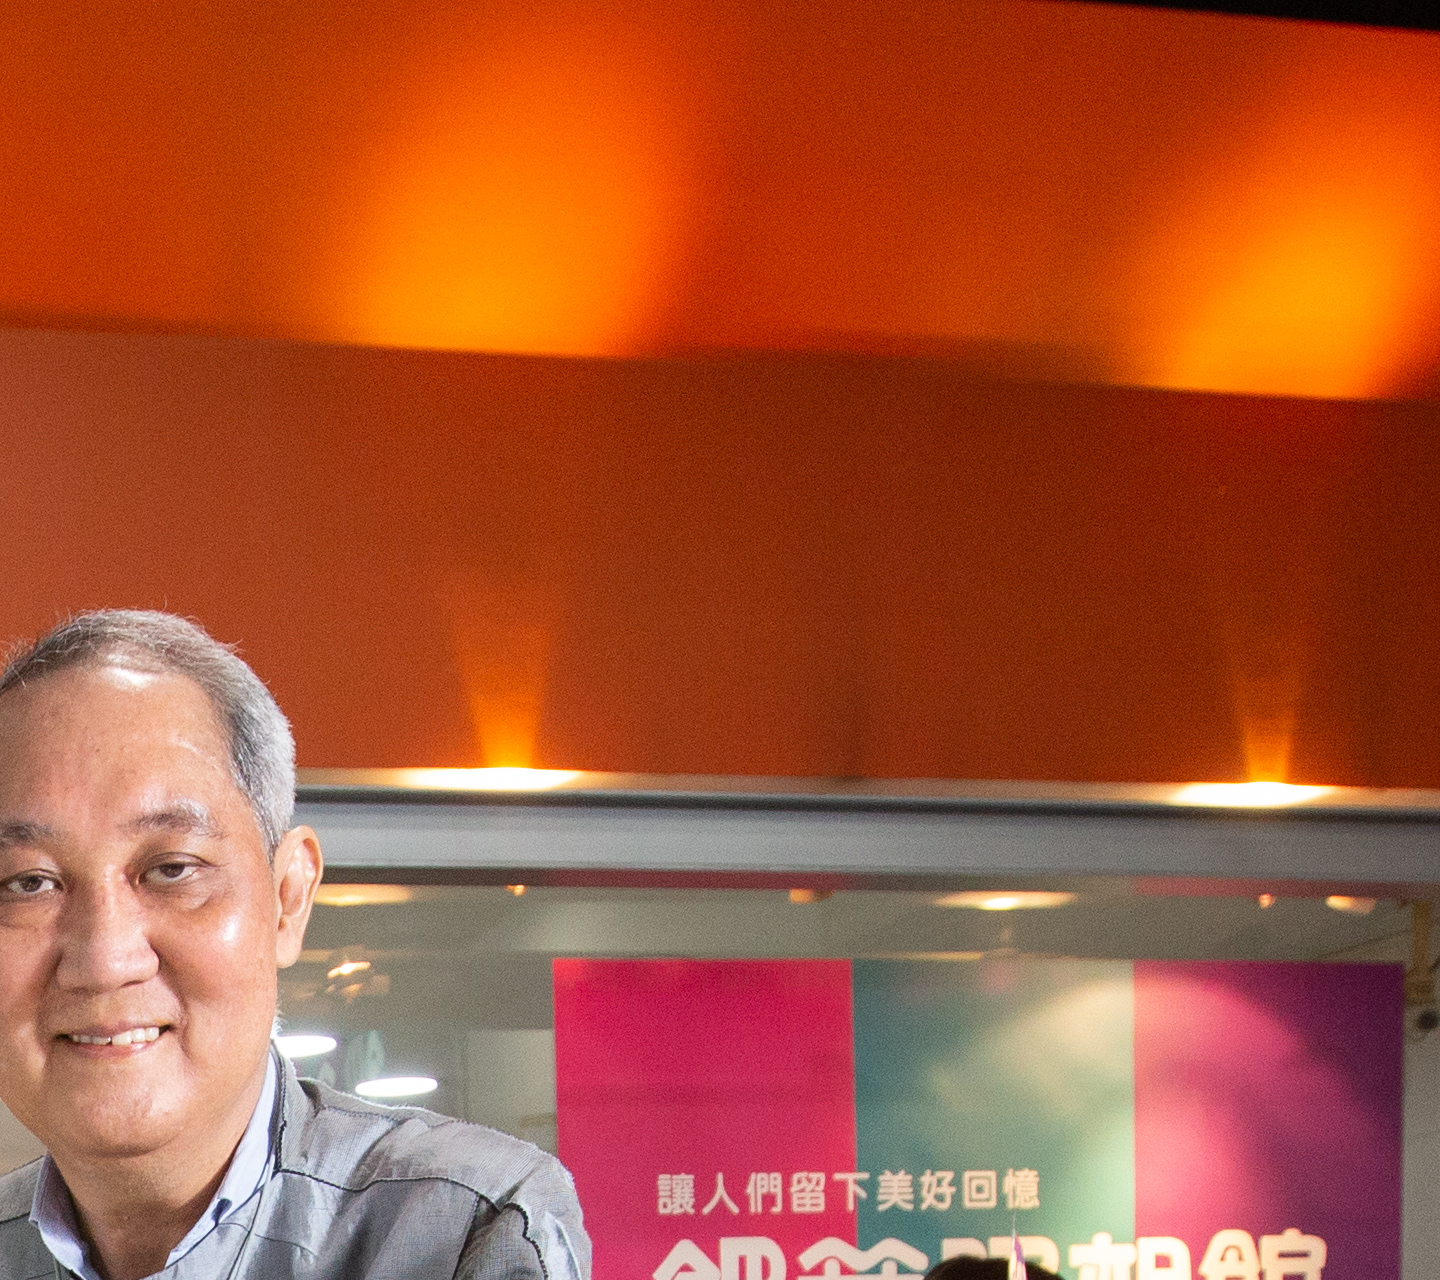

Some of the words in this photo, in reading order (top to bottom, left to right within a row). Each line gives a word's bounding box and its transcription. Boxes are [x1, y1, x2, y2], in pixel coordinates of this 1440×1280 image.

[657, 1168, 1041, 1216] 讓人們留下美好回憶
